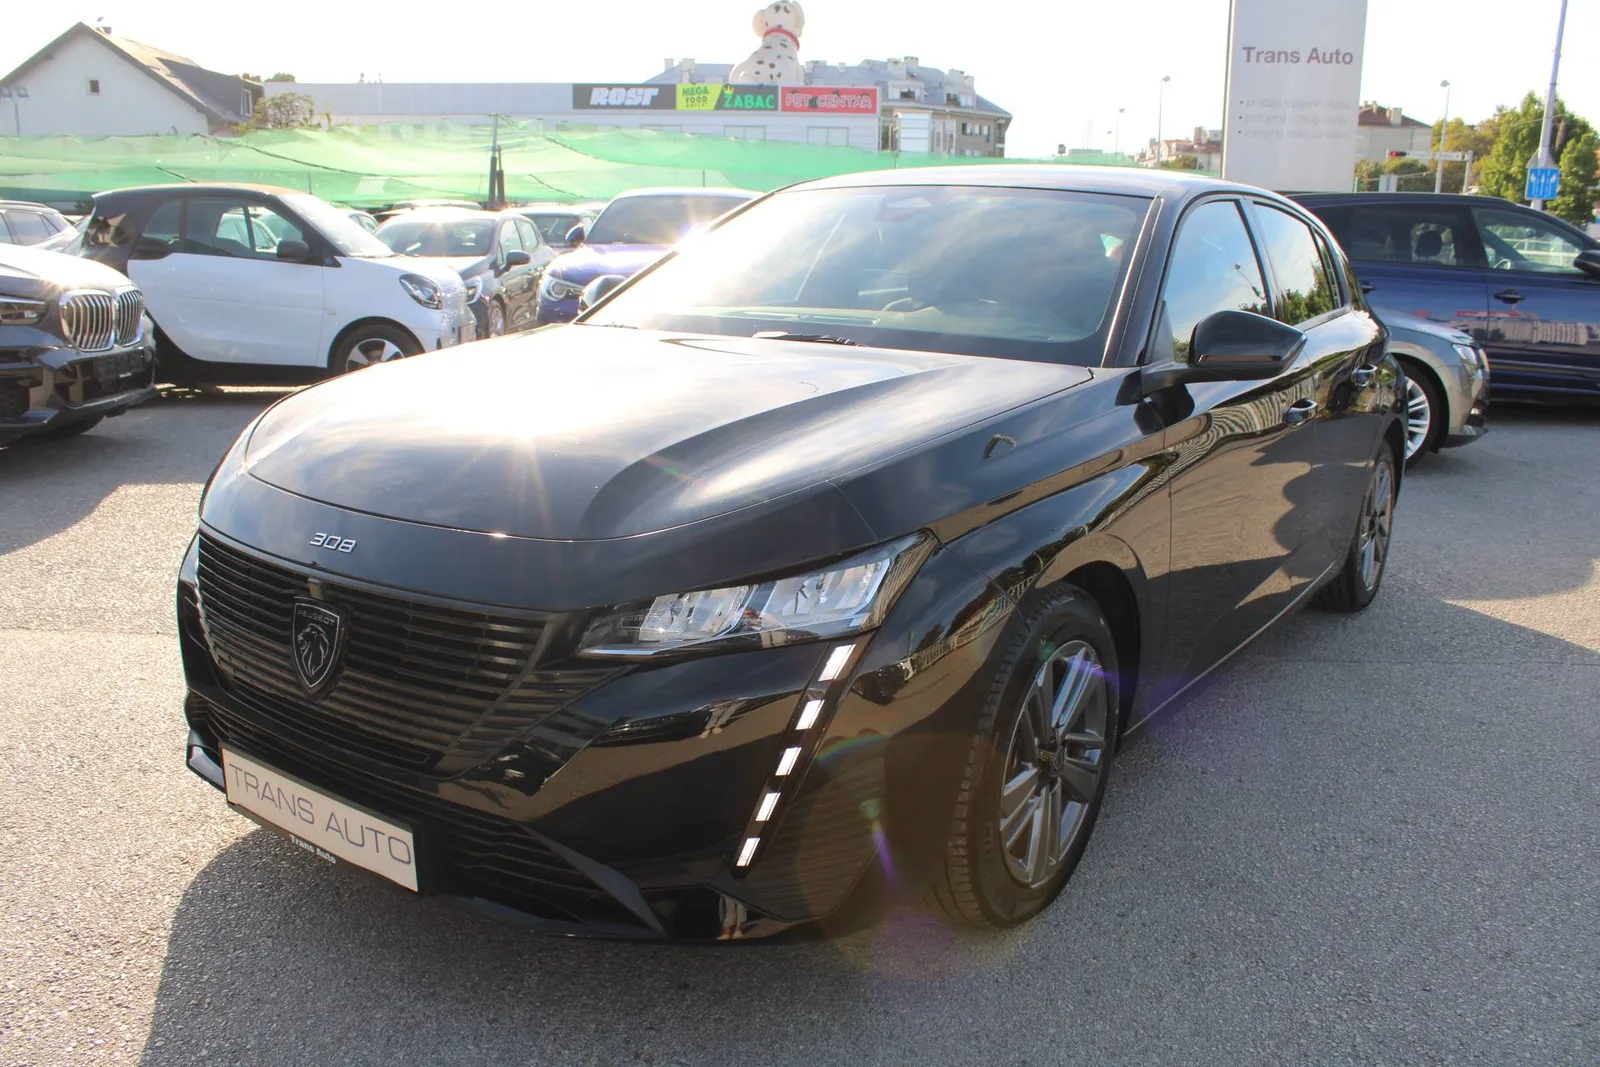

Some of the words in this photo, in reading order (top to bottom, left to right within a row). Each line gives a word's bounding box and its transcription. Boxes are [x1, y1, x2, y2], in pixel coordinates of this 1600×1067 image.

[1242, 46, 1300, 64] Trans
[1306, 47, 1354, 65] Auto
[682, 86, 709, 97] MEGA
[686, 95, 708, 104] FOOD
[785, 93, 813, 108] PET
[816, 93, 873, 109] CENTAR
[310, 532, 356, 553] 308
[229, 763, 315, 825] TRANS
[325, 811, 412, 866] AUTO
[316, 847, 337, 864] Auto
